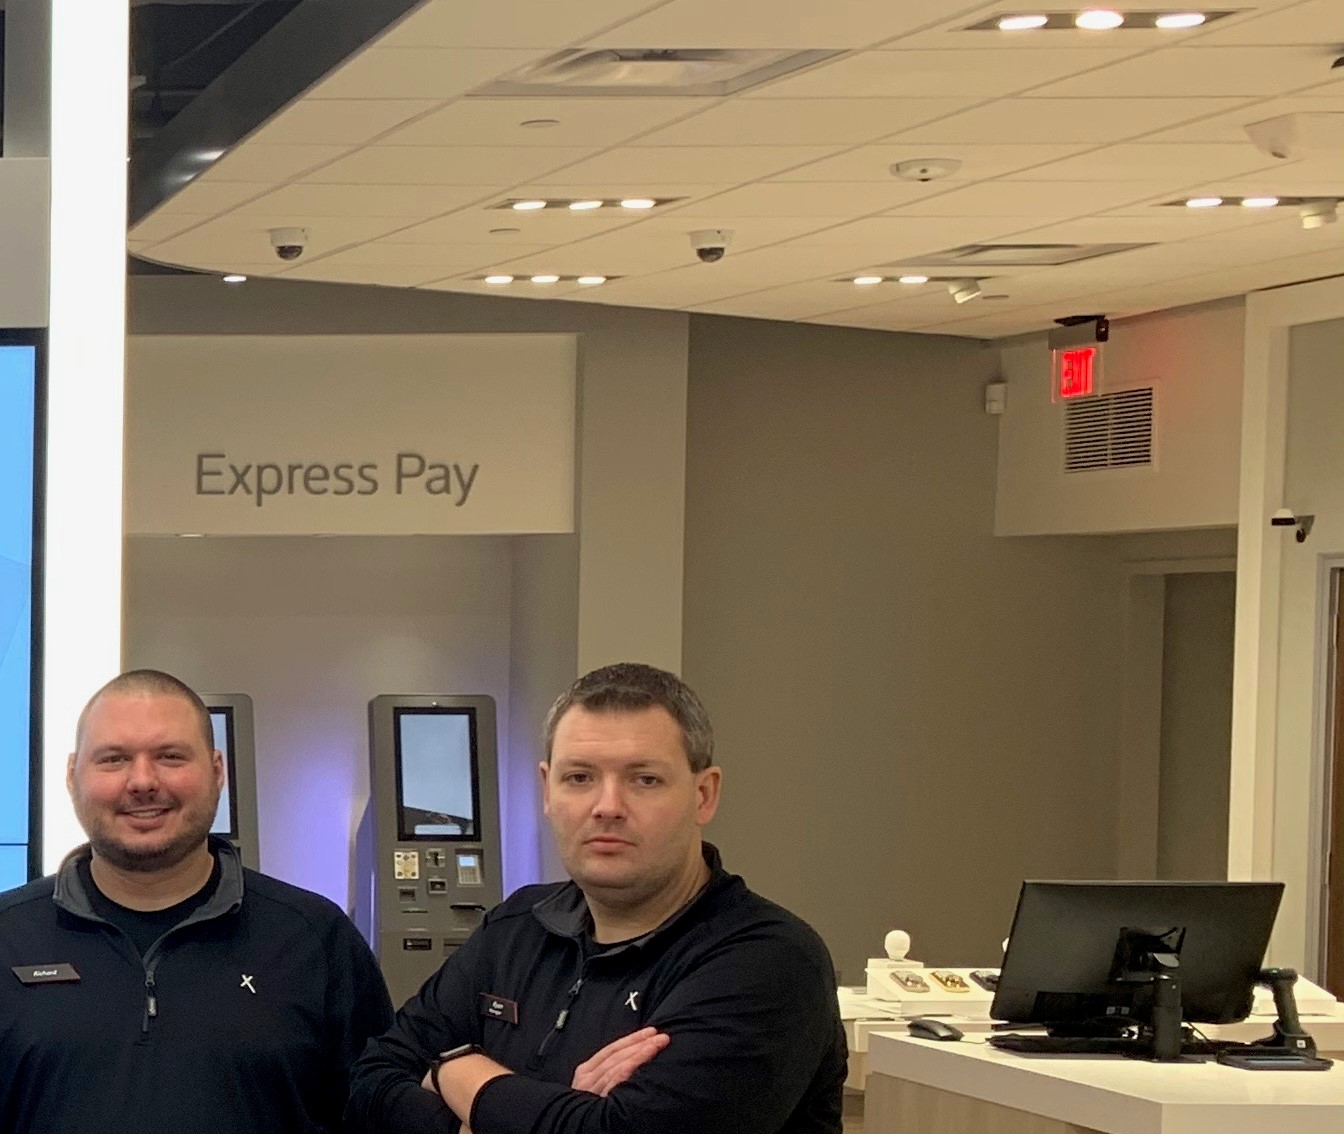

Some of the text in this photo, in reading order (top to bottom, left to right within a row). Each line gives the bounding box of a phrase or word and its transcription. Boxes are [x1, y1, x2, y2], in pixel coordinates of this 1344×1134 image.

[1062, 347, 1096, 398] EXIT
[195, 452, 480, 507] Express Pay
